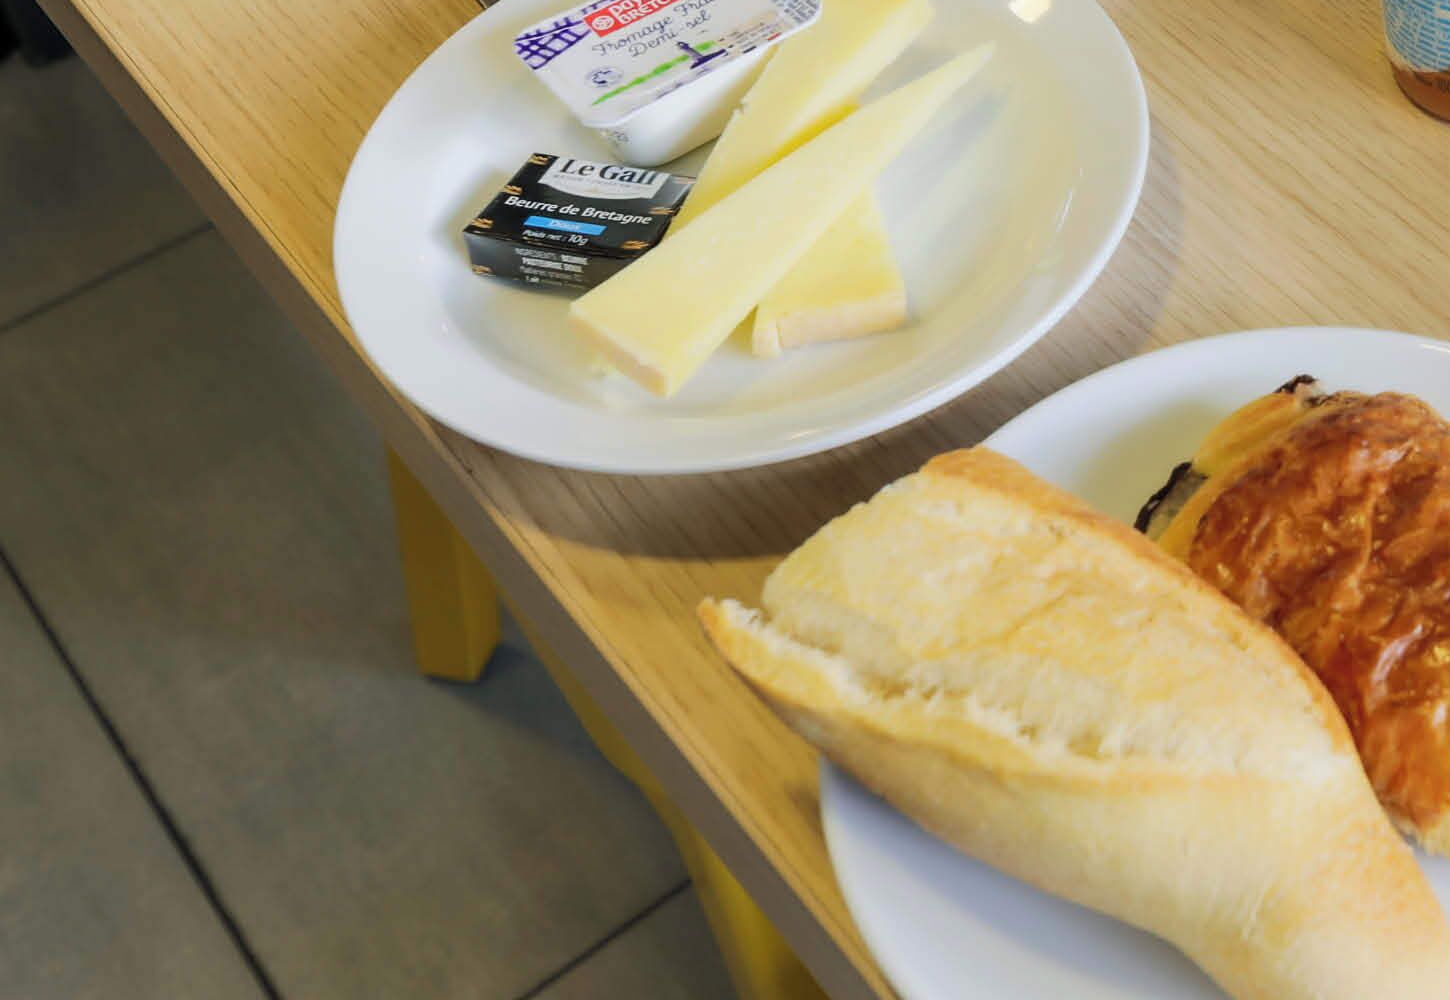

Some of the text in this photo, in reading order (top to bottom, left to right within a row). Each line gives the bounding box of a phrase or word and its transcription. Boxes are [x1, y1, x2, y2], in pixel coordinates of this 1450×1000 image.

[591, 15, 674, 56] Fromage
[559, 158, 595, 176] Le
[598, 163, 657, 186] Gall
[503, 194, 653, 225] Beurre de Bretagne
[567, 233, 590, 246] 10g
